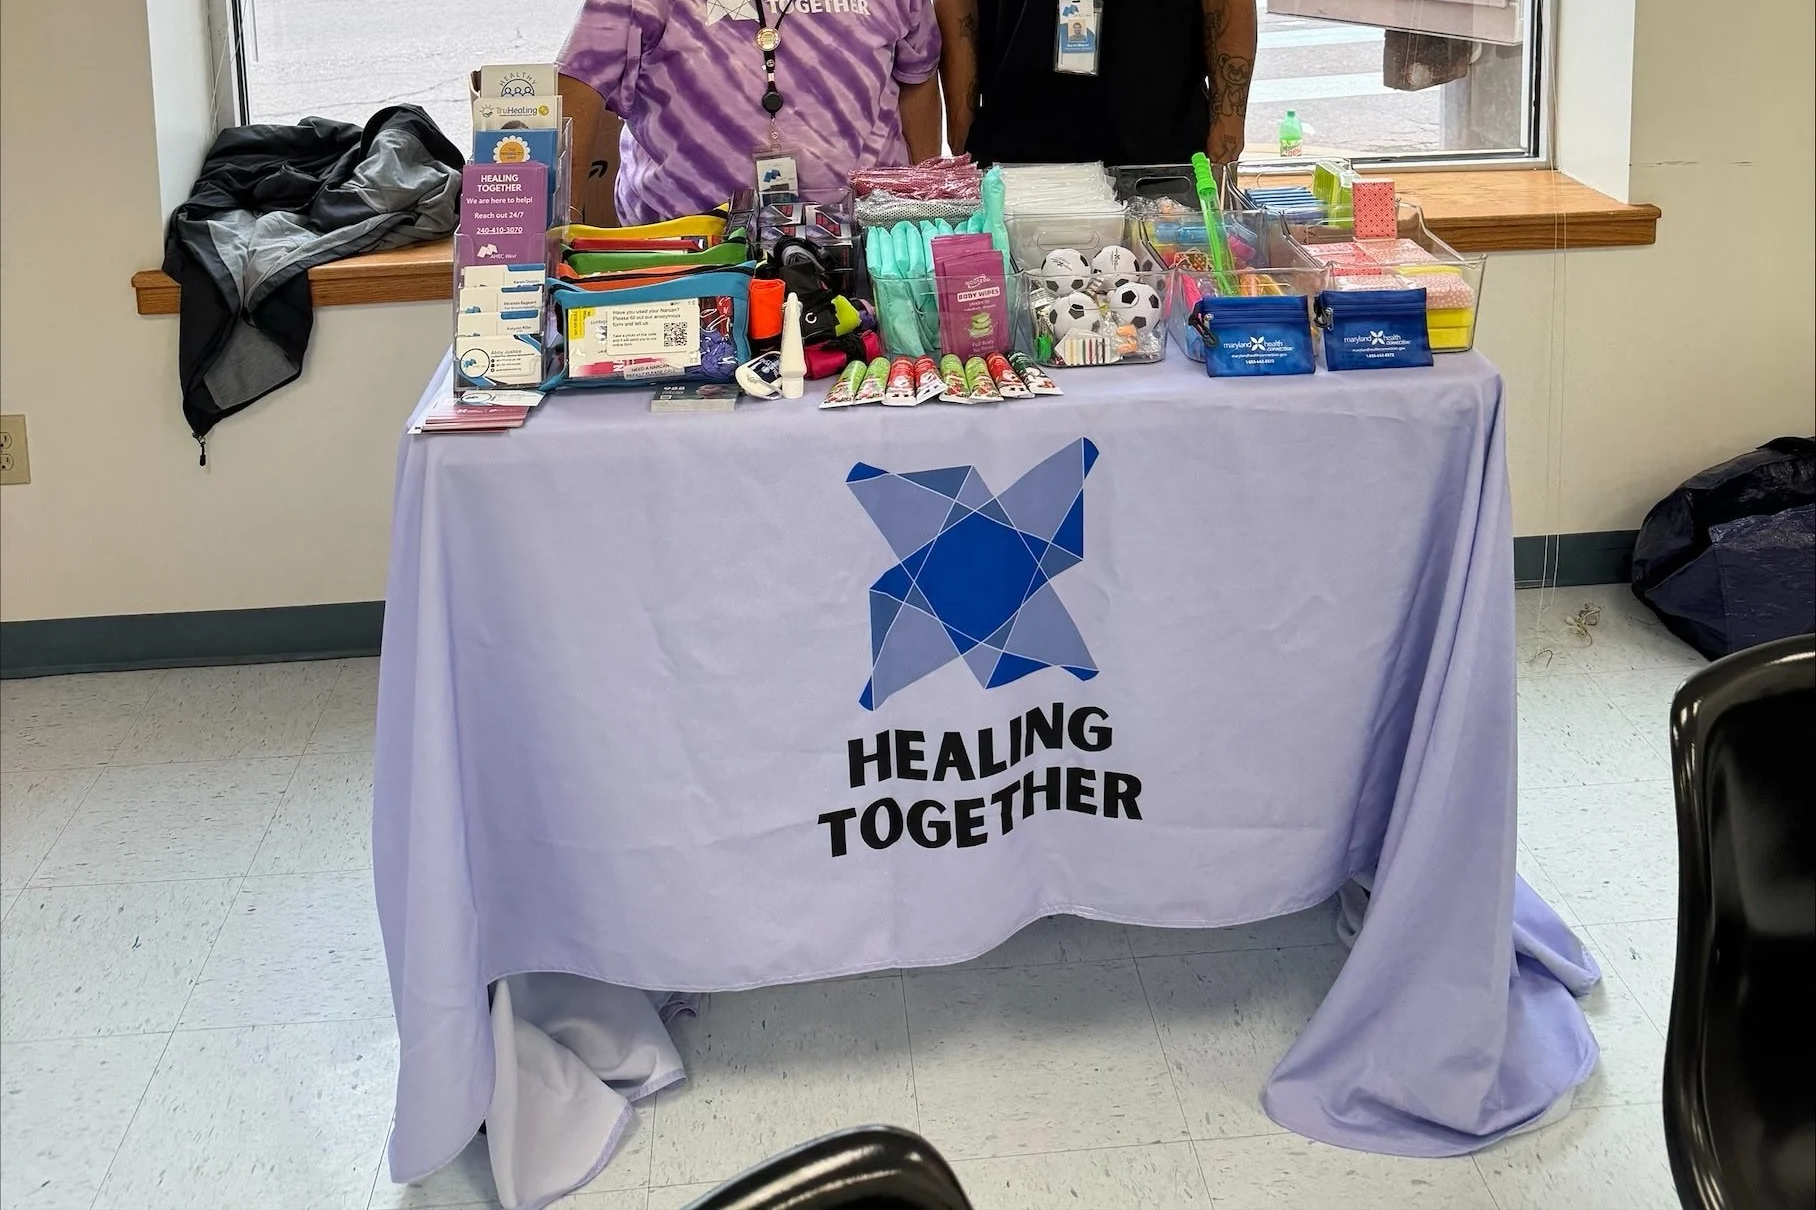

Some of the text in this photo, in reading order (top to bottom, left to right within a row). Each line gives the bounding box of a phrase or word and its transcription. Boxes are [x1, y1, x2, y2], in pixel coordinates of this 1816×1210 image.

[499, 71, 537, 88] HEALTHY
[496, 106, 538, 119] TruHealing
[481, 174, 519, 183] HEALING
[477, 183, 522, 193] TOGETHER
[466, 197, 478, 205] We
[516, 197, 533, 205] help!
[474, 212, 495, 220] Reach
[509, 211, 524, 219] 24/7
[476, 226, 523, 235] 240-410-3070
[958, 289, 999, 300] BODY WIPES
[1344, 333, 1402, 344] maryland health
[1223, 339, 1283, 350] maryland health
[848, 701, 1113, 789] HEALING
[818, 766, 1143, 858] TOGETHER
